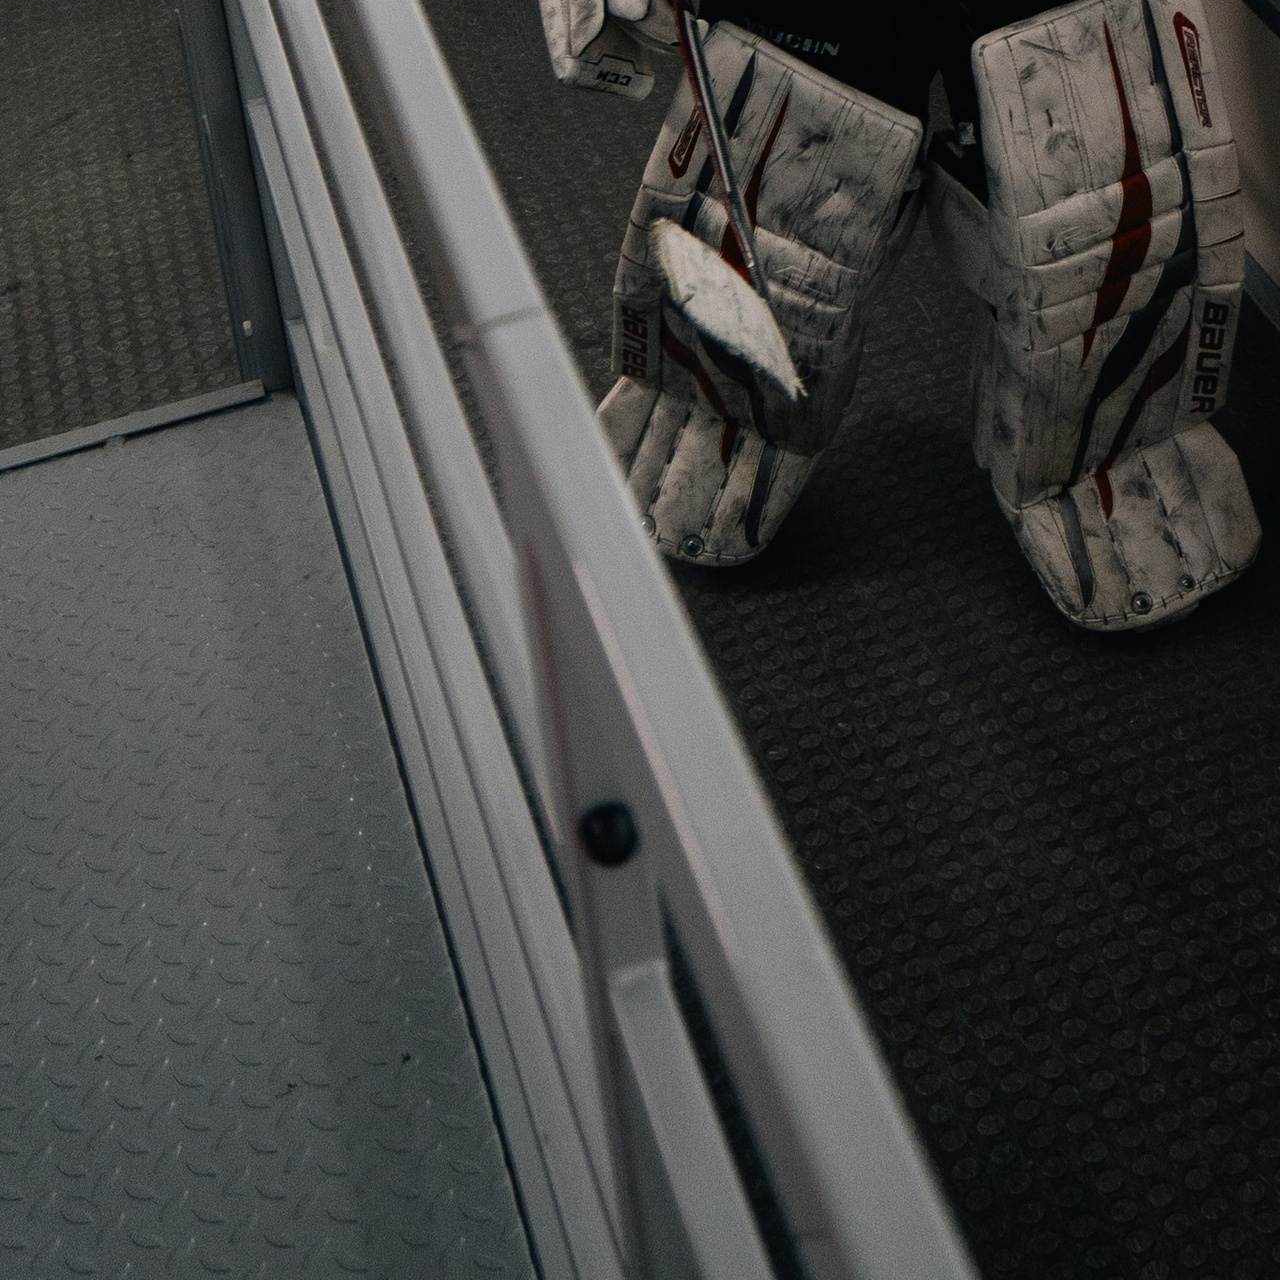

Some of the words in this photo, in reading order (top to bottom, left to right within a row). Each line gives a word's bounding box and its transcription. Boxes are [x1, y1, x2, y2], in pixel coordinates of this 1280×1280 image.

[596, 69, 633, 87] CCM
[620, 304, 650, 380] BAUER
[1188, 298, 1230, 416] BAUER
